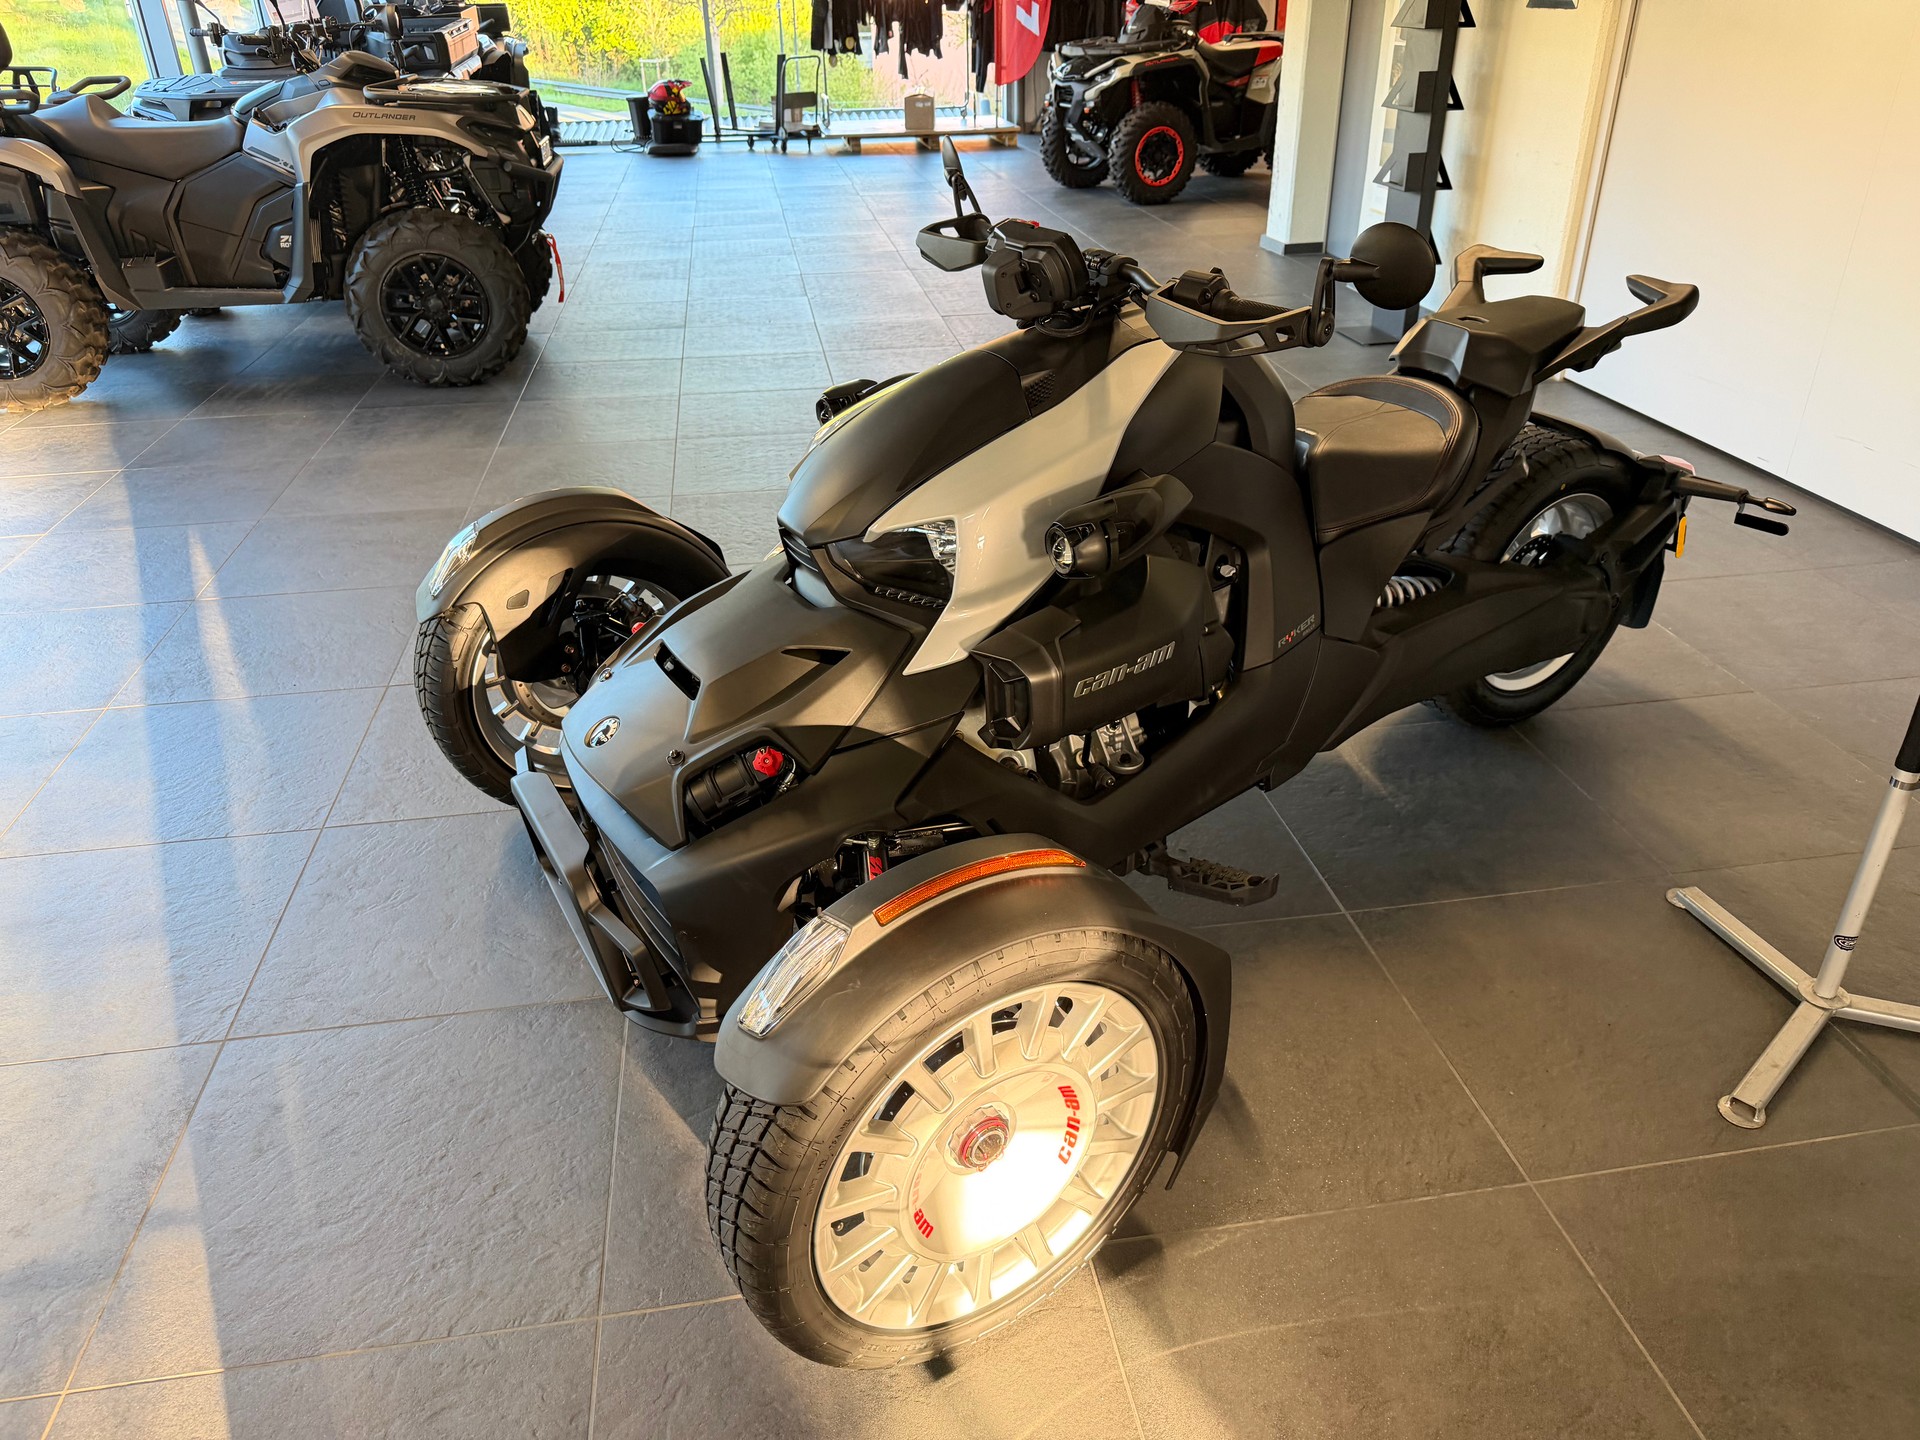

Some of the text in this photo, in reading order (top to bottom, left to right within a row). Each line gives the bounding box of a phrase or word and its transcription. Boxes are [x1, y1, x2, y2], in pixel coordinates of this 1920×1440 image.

[352, 111, 416, 121] OUTLANDER
[1278, 614, 1315, 648] RYKER
[1073, 640, 1176, 698] can-am
[1057, 1085, 1081, 1165] can-am
